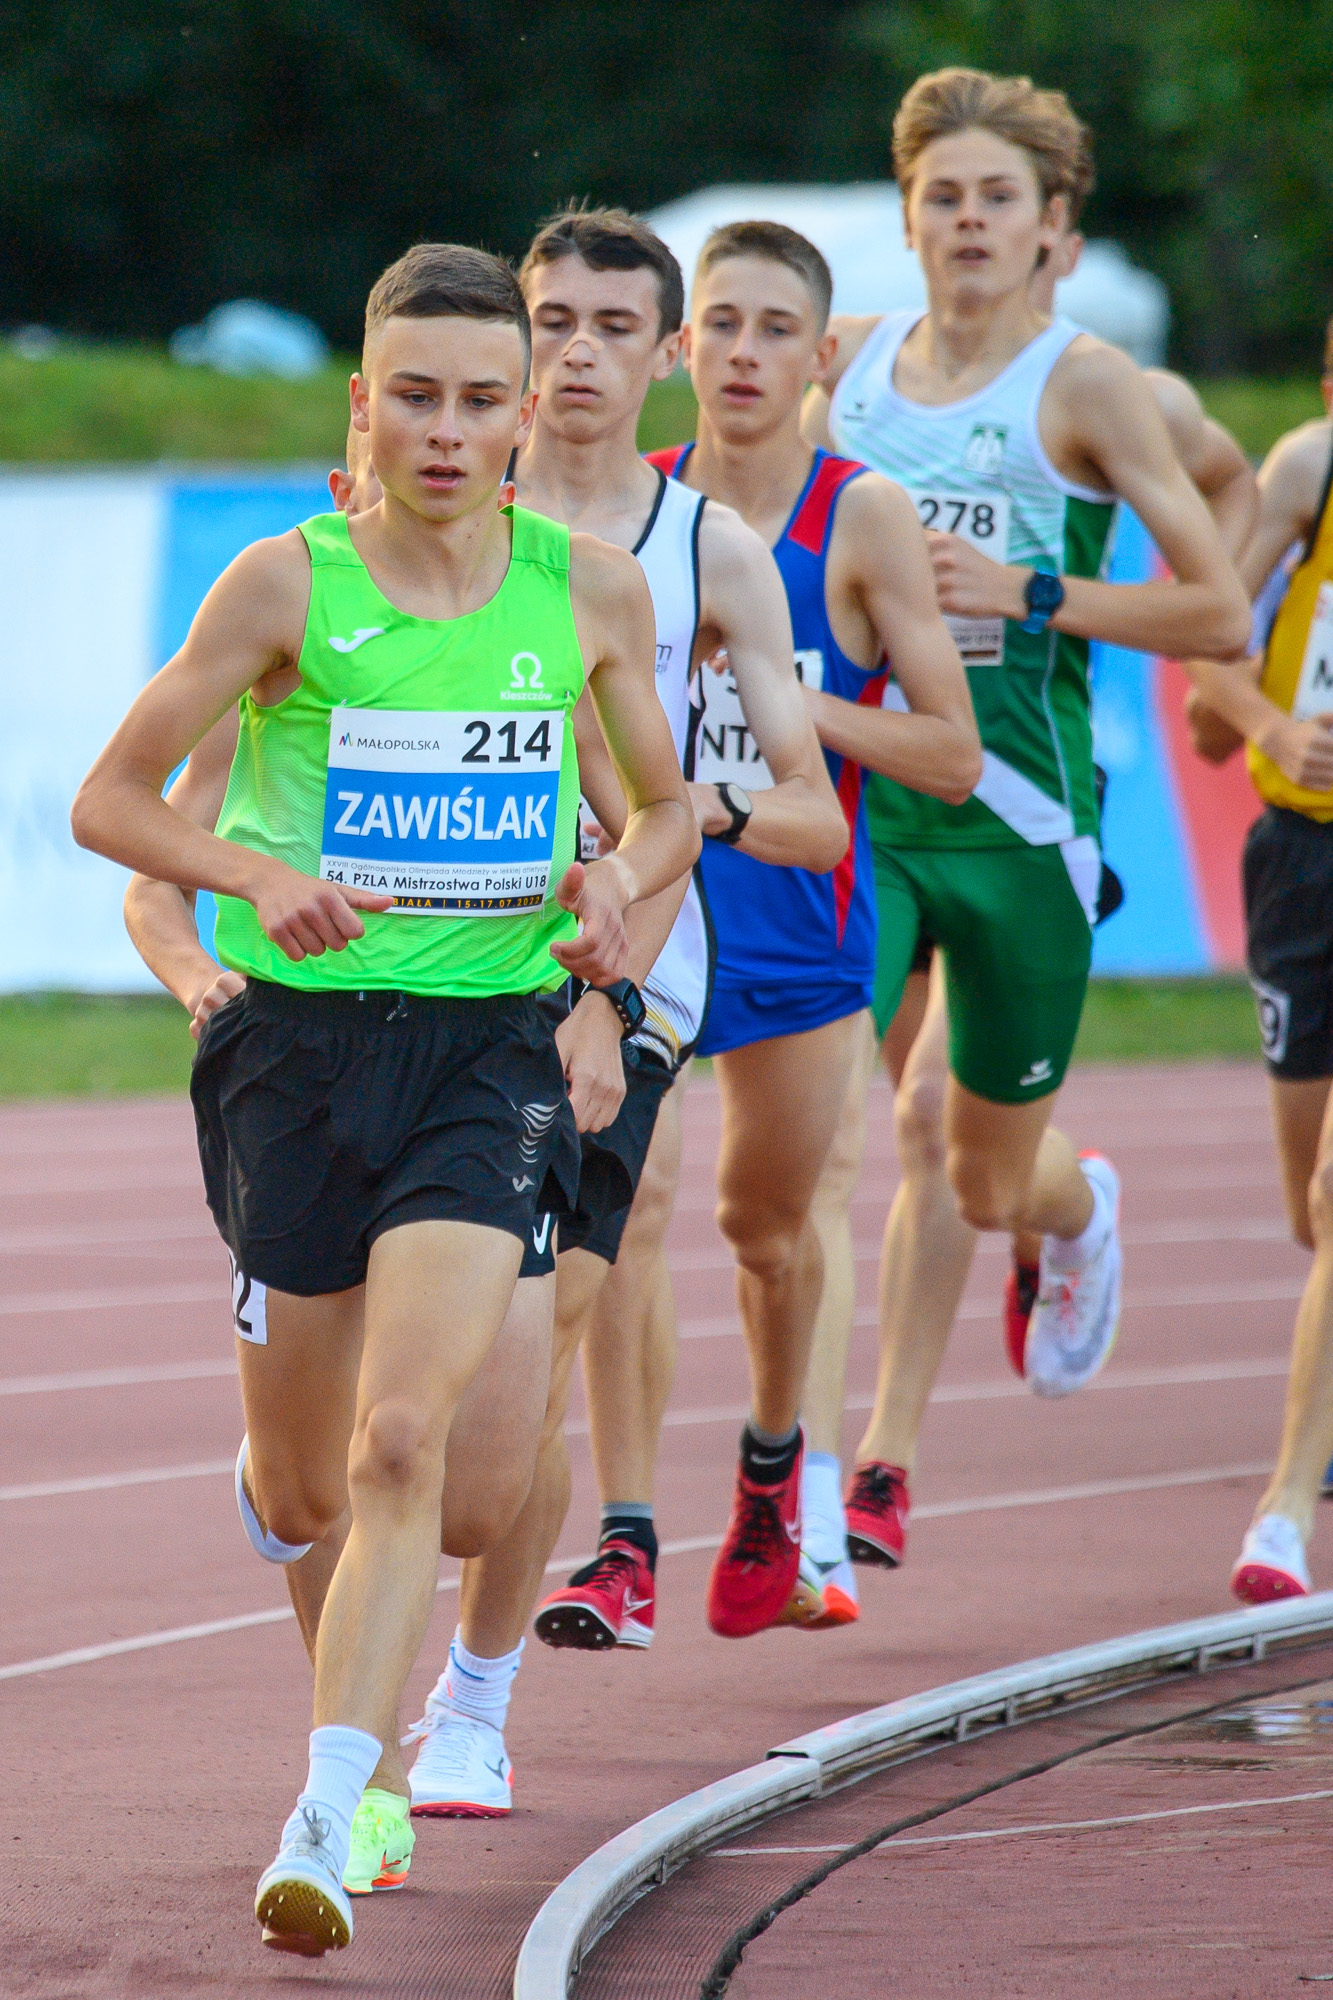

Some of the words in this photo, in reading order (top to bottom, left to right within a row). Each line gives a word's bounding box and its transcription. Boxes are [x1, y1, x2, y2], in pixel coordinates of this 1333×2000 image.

[920, 498, 994, 538] 278
[357, 738, 440, 751] MAŁOPOLSKA
[461, 719, 552, 763] 214
[334, 786, 550, 841] ZAWIŚLAK
[326, 860, 349, 868] XXVIII
[350, 862, 406, 874] Ogólnopolska
[408, 866, 450, 876] Olimpiada
[452, 867, 490, 876] Młodzieży
[500, 866, 520, 876] lekkiej
[522, 865, 549, 875] atletyce
[326, 870, 347, 884] 54.
[353, 873, 388, 888] PZLA
[393, 876, 479, 891] Mistrzostwa
[484, 876, 522, 891] Polski
[525, 875, 547, 889] U18
